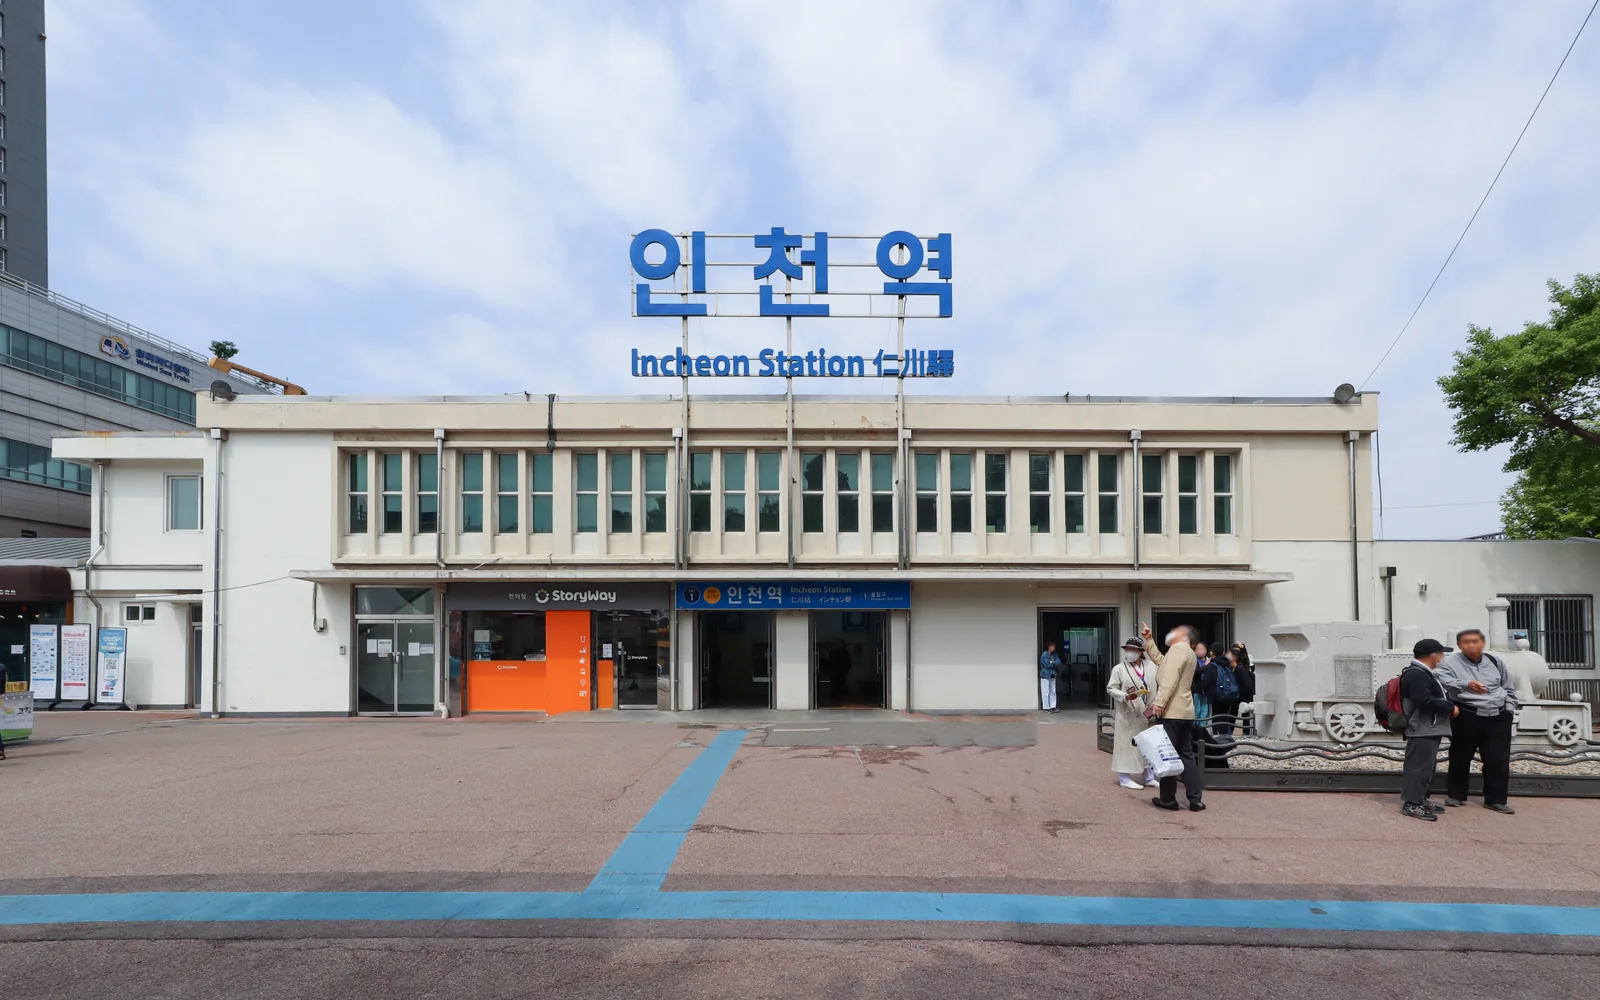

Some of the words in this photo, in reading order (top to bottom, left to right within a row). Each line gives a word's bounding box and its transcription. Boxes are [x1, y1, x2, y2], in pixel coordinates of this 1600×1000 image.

[629, 227, 953, 318] 인천역
[136, 358, 159, 371] Wolmi
[159, 367, 173, 377] Sea
[173, 372, 190, 384] Train
[631, 347, 750, 377] Incheon
[758, 347, 864, 377] Station
[873, 348, 955, 378] 仁川驛
[552, 589, 617, 603] StoryWay
[689, 593, 694, 602] 1
[727, 586, 782, 604] 인천역
[790, 586, 822, 594] Incheon
[823, 586, 852, 594] Station
